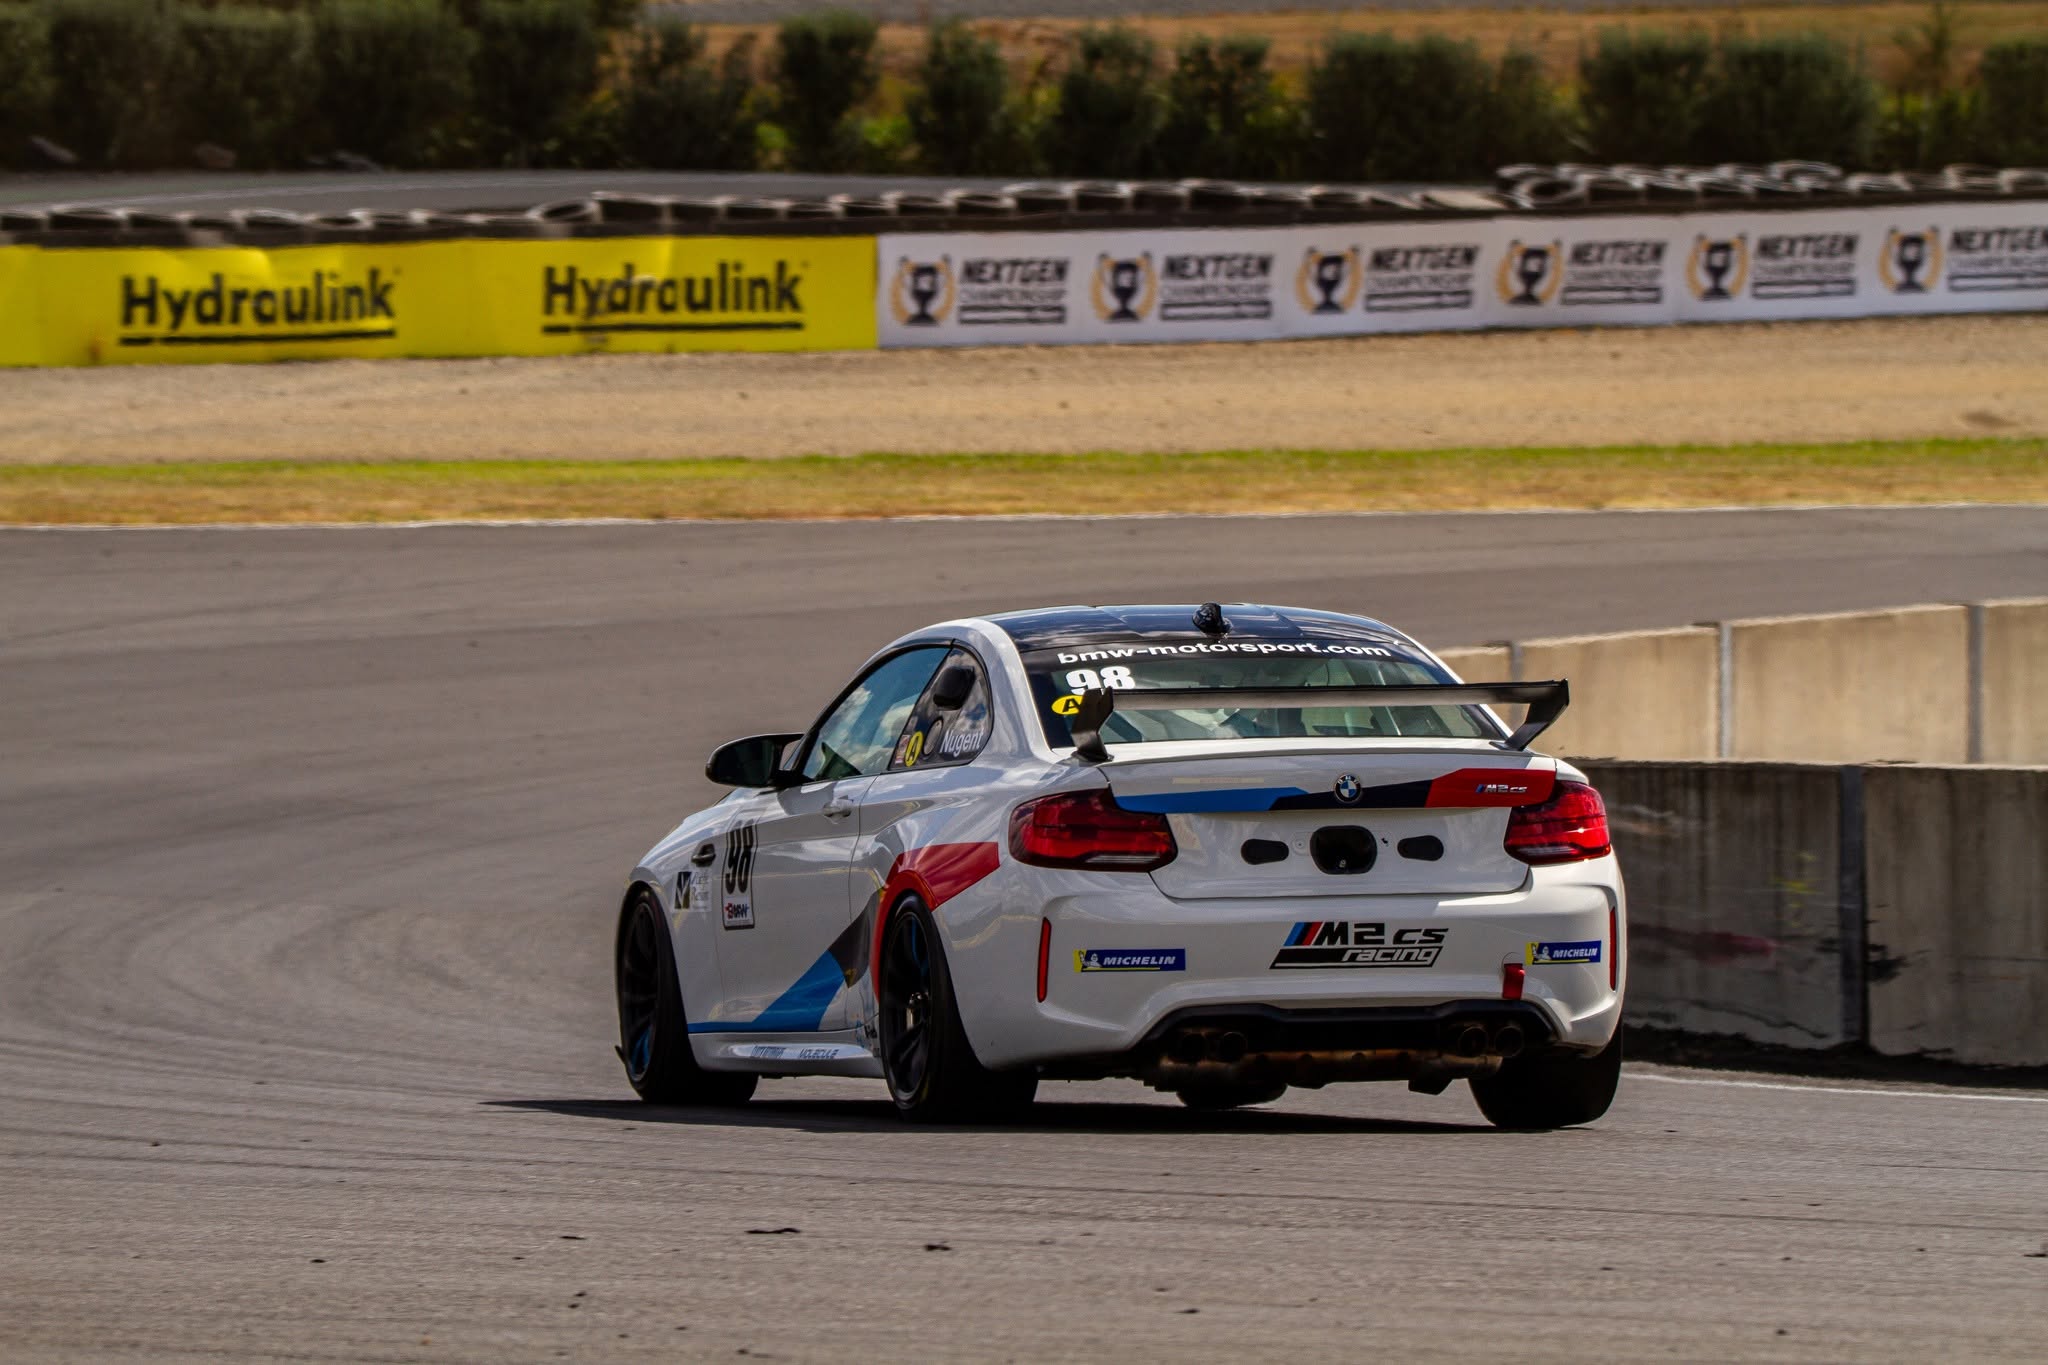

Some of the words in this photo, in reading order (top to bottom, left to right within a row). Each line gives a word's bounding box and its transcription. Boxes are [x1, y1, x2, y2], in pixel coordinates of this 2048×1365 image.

[1366, 244, 1481, 272] NEXTGEN
[1568, 241, 1669, 267] NEXTGEN
[1754, 234, 1859, 260] NEXTGEN
[958, 258, 1069, 284] NEXTGEN
[1160, 254, 1274, 281] NEXTGEN
[121, 268, 394, 330] Hydraulink
[543, 261, 802, 321] Hydraulink
[1057, 641, 1392, 664] bmw-motorsport.com
[1066, 666, 1136, 695] 98
[1062, 698, 1081, 713] A
[939, 730, 984, 758] Nugent
[1102, 955, 1176, 966] MICHELIN
[1341, 947, 1436, 962] racing
[1552, 947, 1598, 958] MICHELIN
